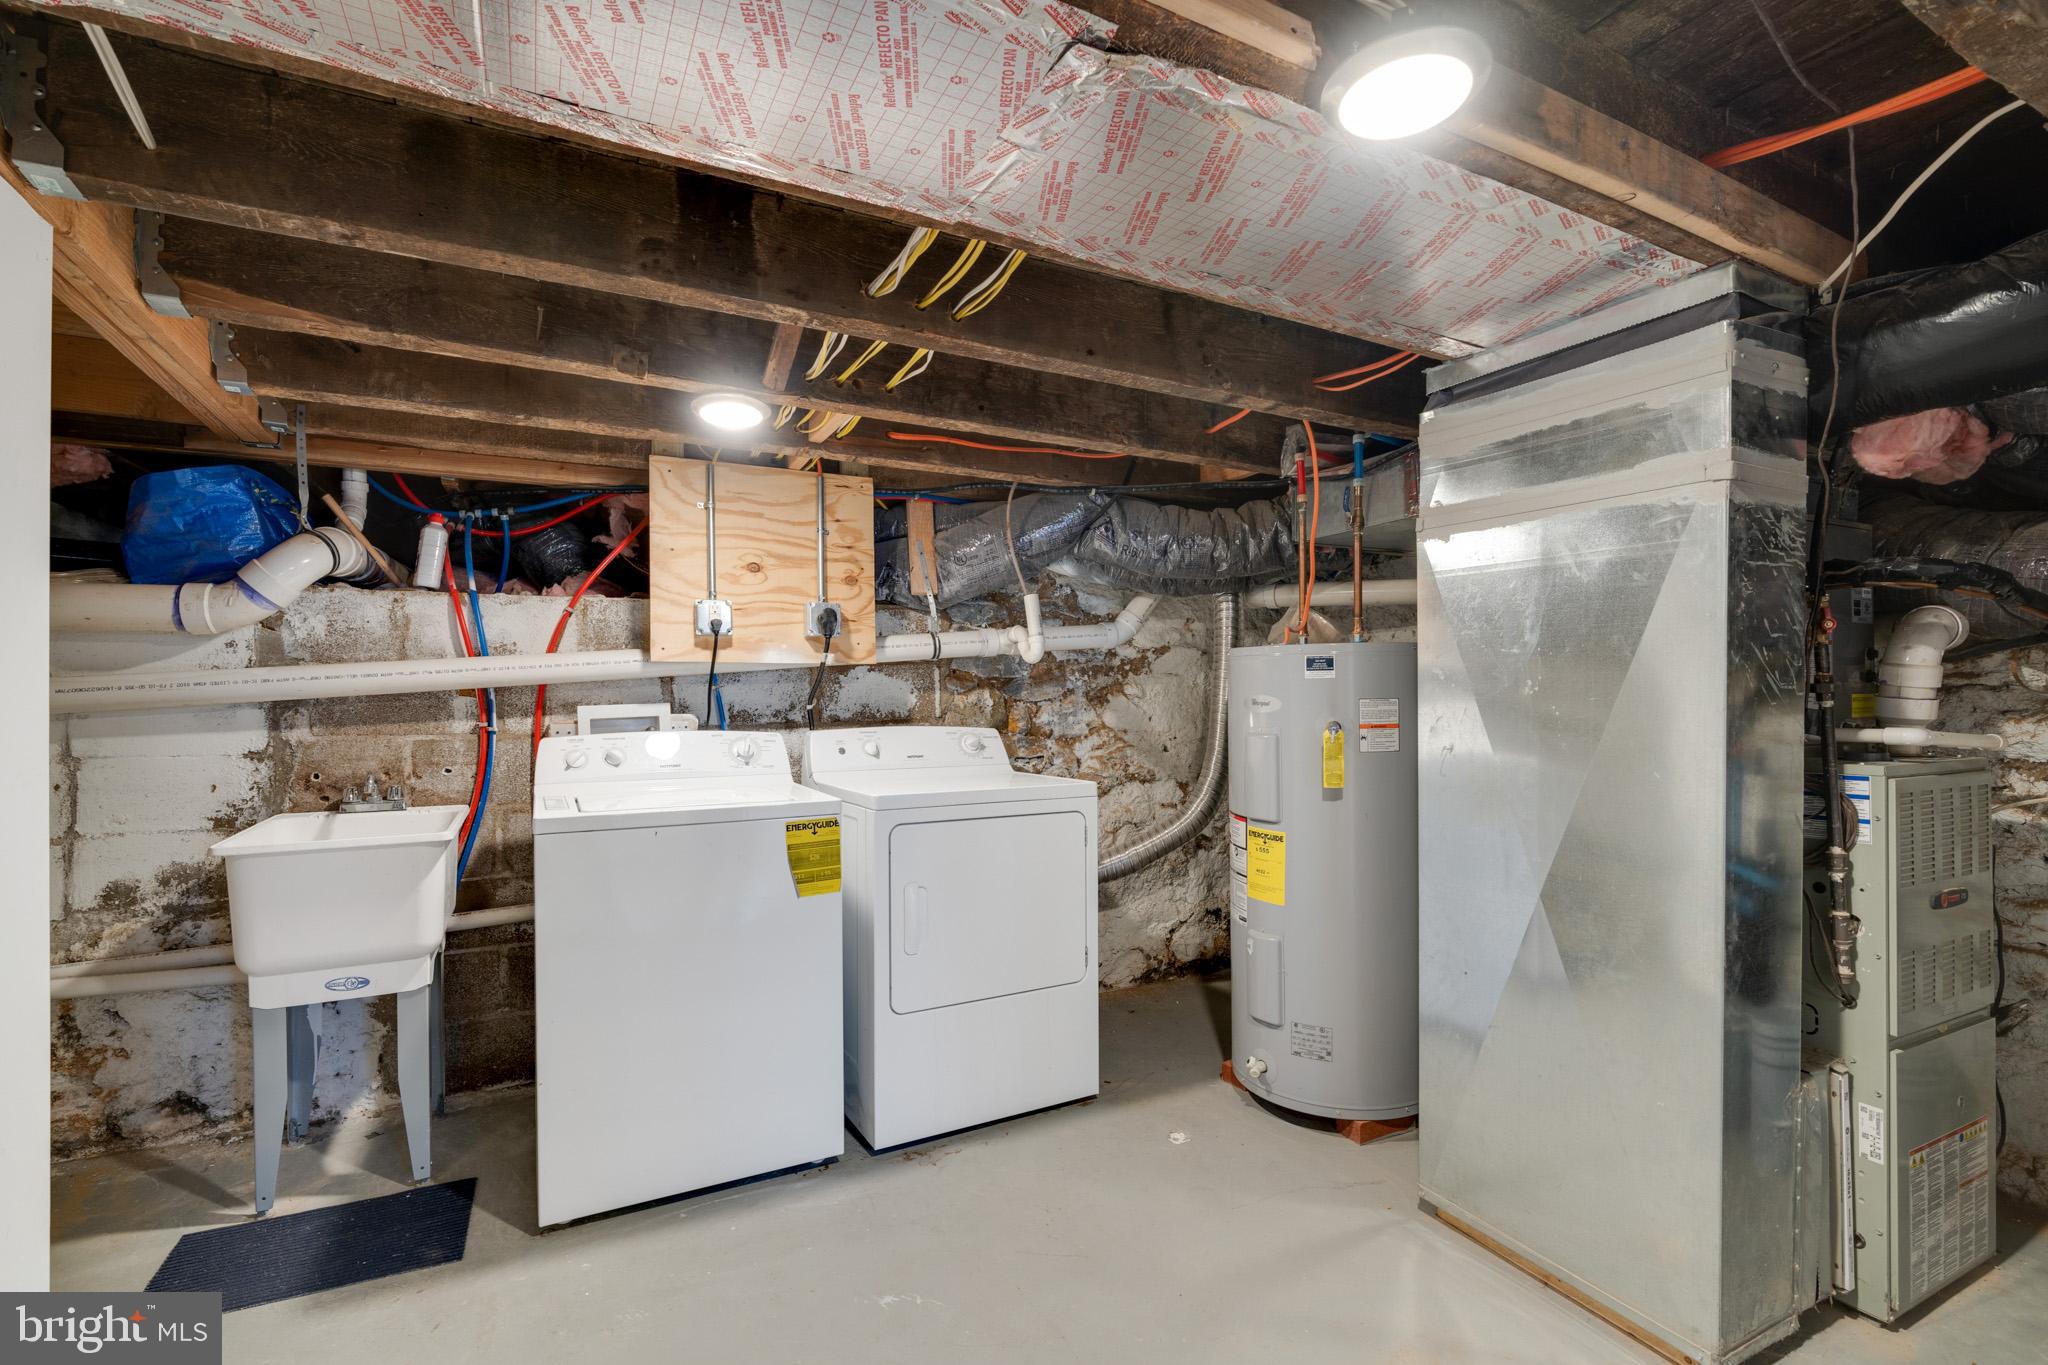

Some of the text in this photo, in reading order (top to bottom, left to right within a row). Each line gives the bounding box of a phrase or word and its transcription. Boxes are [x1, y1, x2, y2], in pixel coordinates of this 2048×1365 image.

[874, 0, 889, 21] PAN
[876, 24, 892, 68] REFLECTO
[589, 52, 622, 88] REFLECTO
[611, 90, 632, 105] PAN
[1000, 48, 1016, 107] REFLECTO PAN
[786, 820, 840, 833] ENERGYGUIDE
[1248, 829, 1284, 843] ENERGYGUIDE
